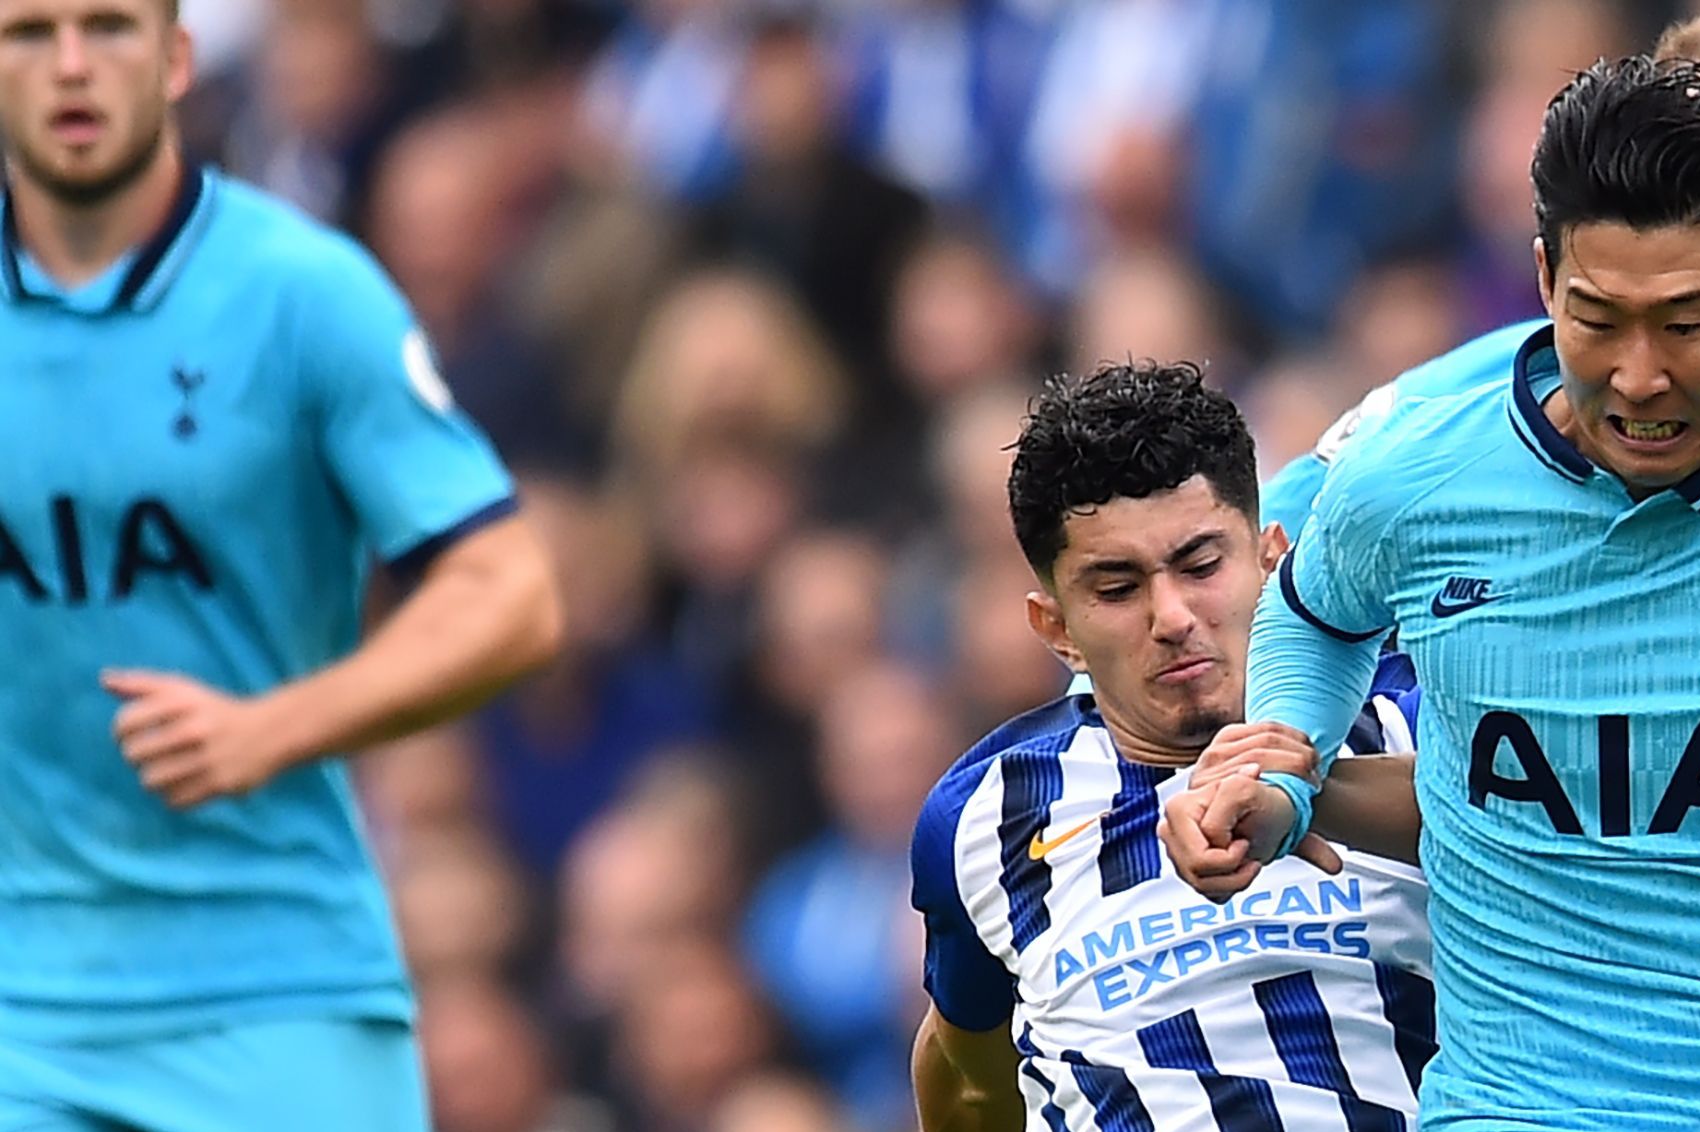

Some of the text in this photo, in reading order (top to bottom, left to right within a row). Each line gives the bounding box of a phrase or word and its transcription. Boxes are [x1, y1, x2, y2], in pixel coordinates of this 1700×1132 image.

[1441, 575, 1493, 601] NIKE
[1055, 877, 1363, 988] AMERICAN
[1093, 921, 1371, 1013] EXPRESS
